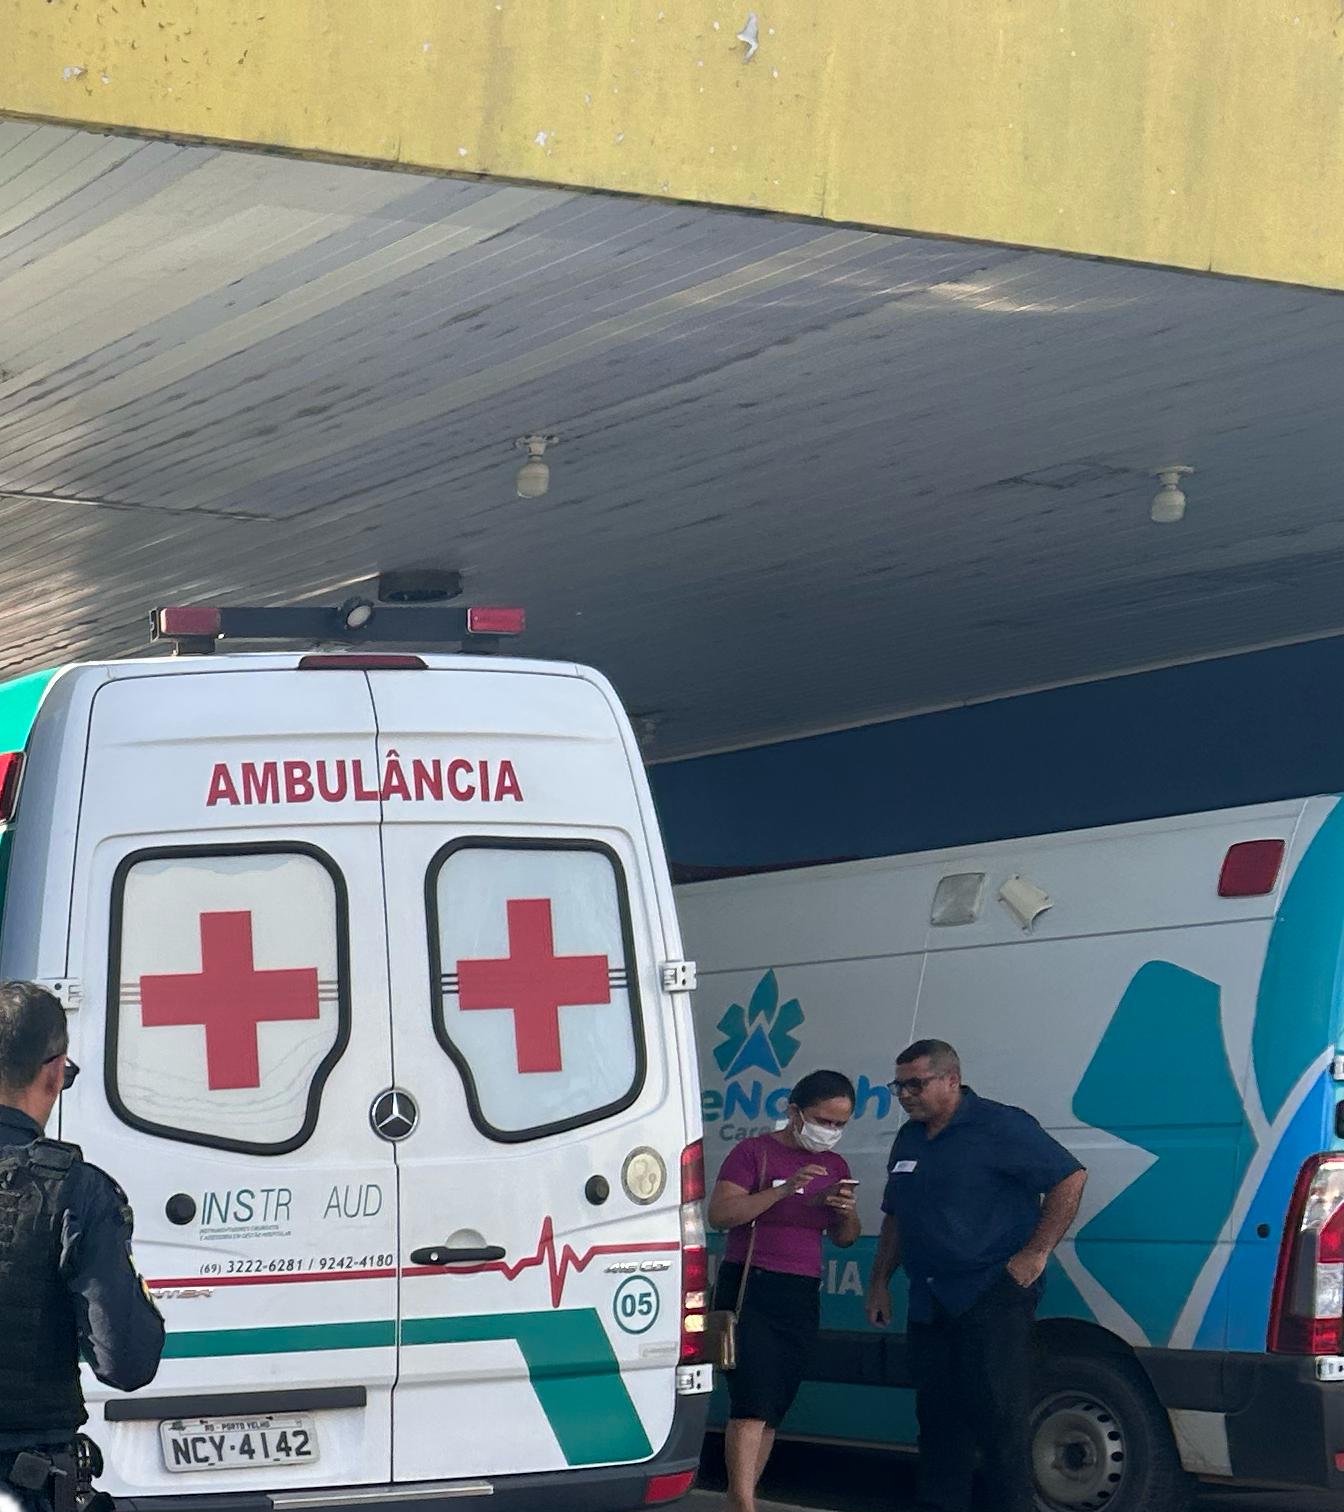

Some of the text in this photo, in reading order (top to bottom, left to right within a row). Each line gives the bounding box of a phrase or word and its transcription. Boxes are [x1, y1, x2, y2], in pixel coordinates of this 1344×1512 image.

[205, 748, 525, 807] AMBULÂNCIA
[200, 1183, 383, 1226] INSTR AUD
[199, 1263, 222, 1275] (69)
[226, 1258, 302, 1274] 3222-6281
[318, 1253, 394, 1270] 9242-4180
[620, 1291, 653, 1318] 05
